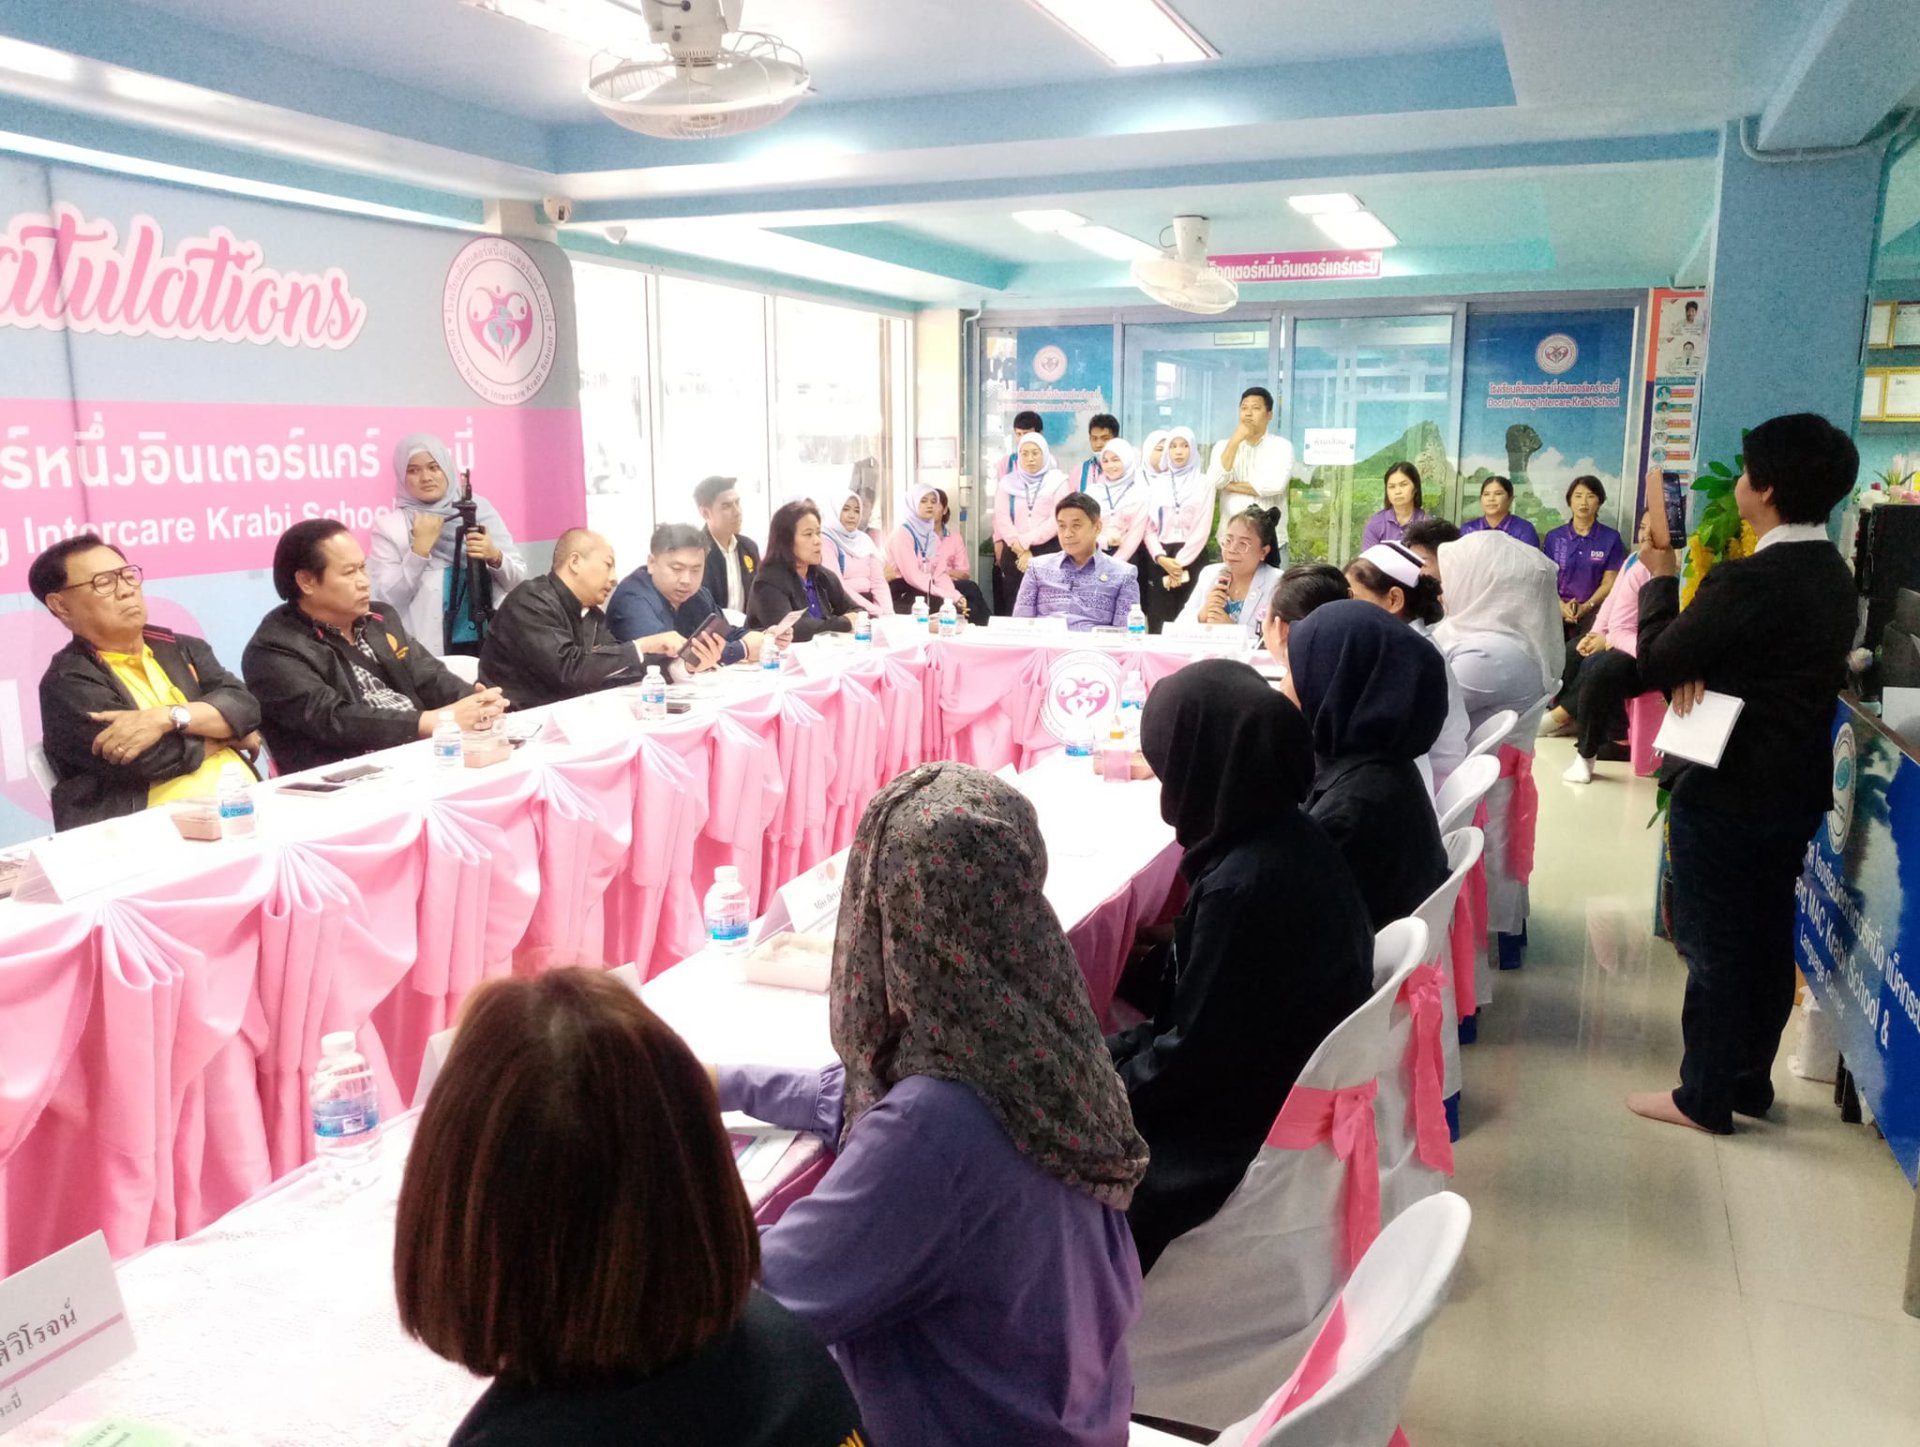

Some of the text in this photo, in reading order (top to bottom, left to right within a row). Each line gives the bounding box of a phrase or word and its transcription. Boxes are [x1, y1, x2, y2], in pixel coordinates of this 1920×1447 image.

[526, 371, 544, 396] Krabi
[541, 336, 553, 372] School
[1487, 397, 1511, 408] Doctor
[1512, 397, 1537, 409] Nueng
[1572, 397, 1592, 407] Krabi
[1593, 397, 1619, 407] School
[24, 514, 196, 554] Intercare
[206, 503, 292, 541] Krabi
[1800, 922, 1825, 982] Language
[1808, 889, 1827, 938] MAC
[1826, 917, 1849, 974] Krabi
[1848, 954, 1880, 1031] School
[1880, 1009, 1889, 1050] &
